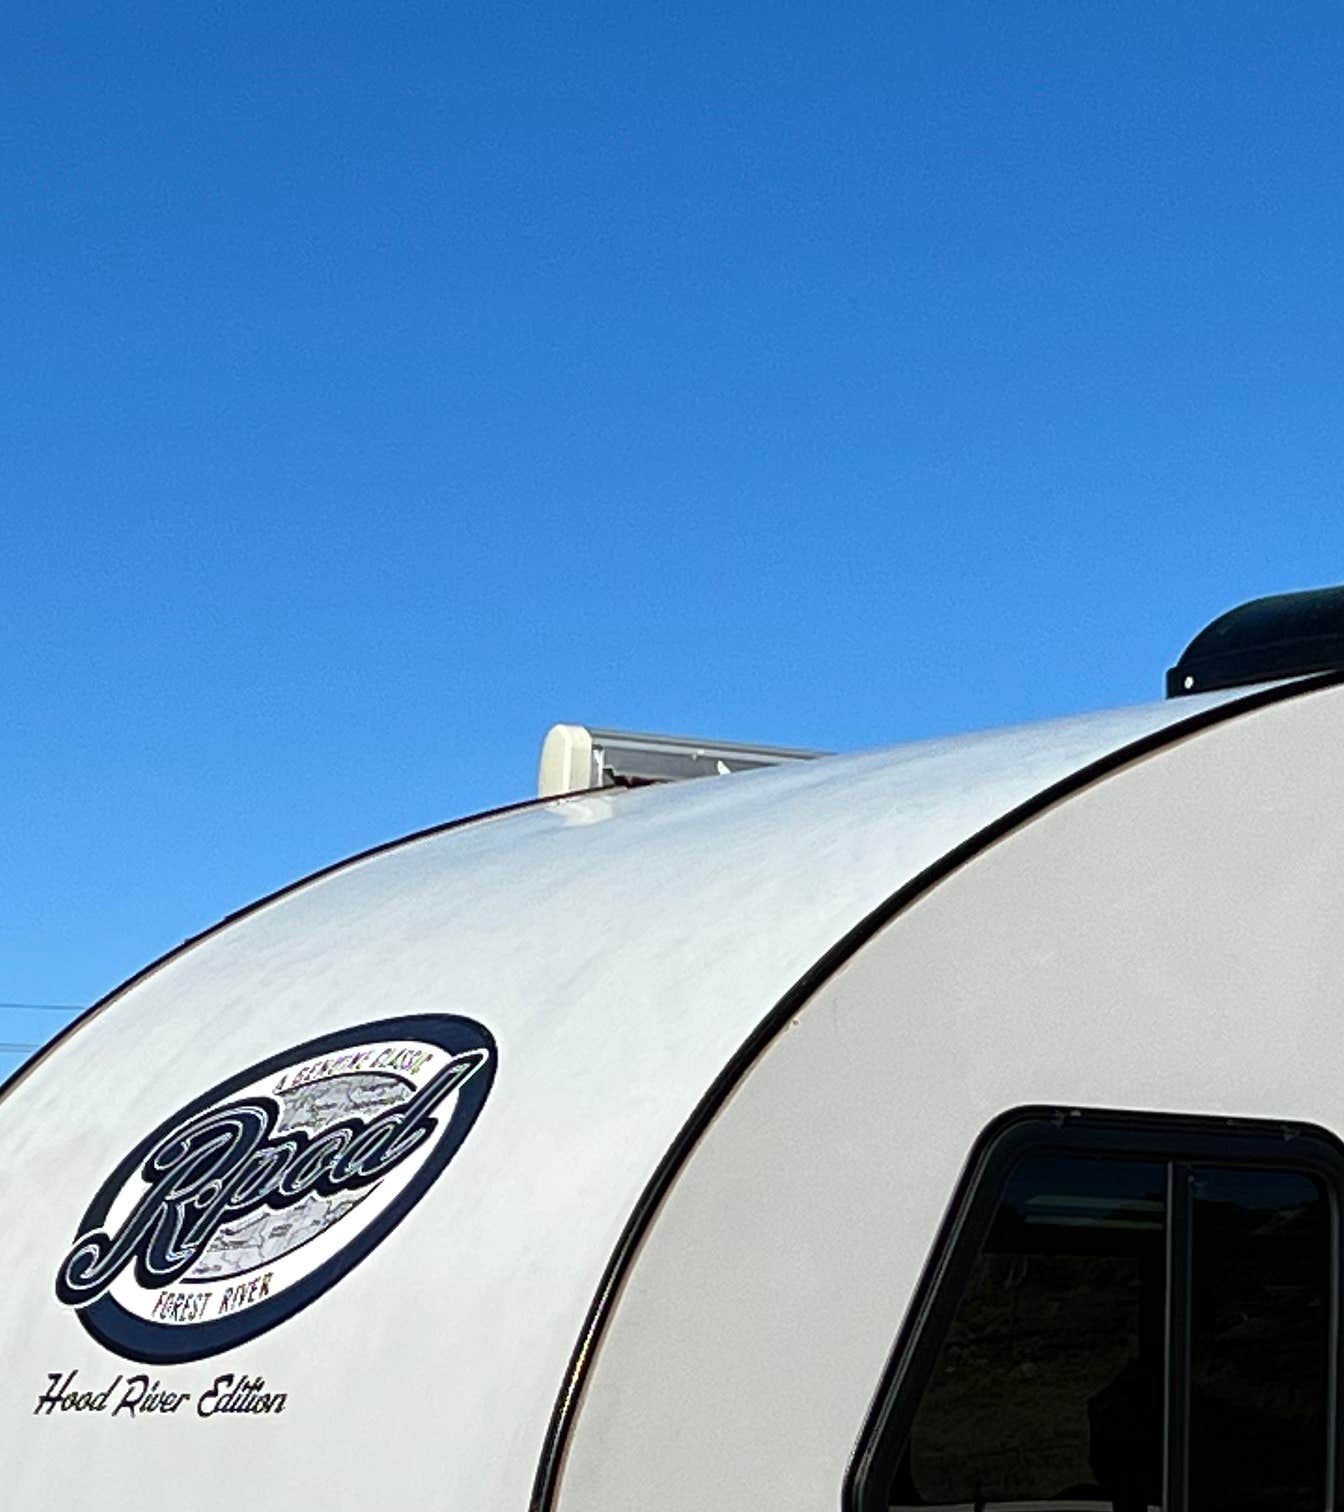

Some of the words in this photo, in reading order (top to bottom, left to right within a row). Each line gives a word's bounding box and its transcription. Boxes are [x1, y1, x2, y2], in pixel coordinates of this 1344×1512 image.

[152, 1290, 213, 1322] FOREST
[218, 1272, 275, 1315] RIVER
[33, 1369, 123, 1416] Hood
[111, 1374, 191, 1418] River
[197, 1373, 289, 1418] Edition
